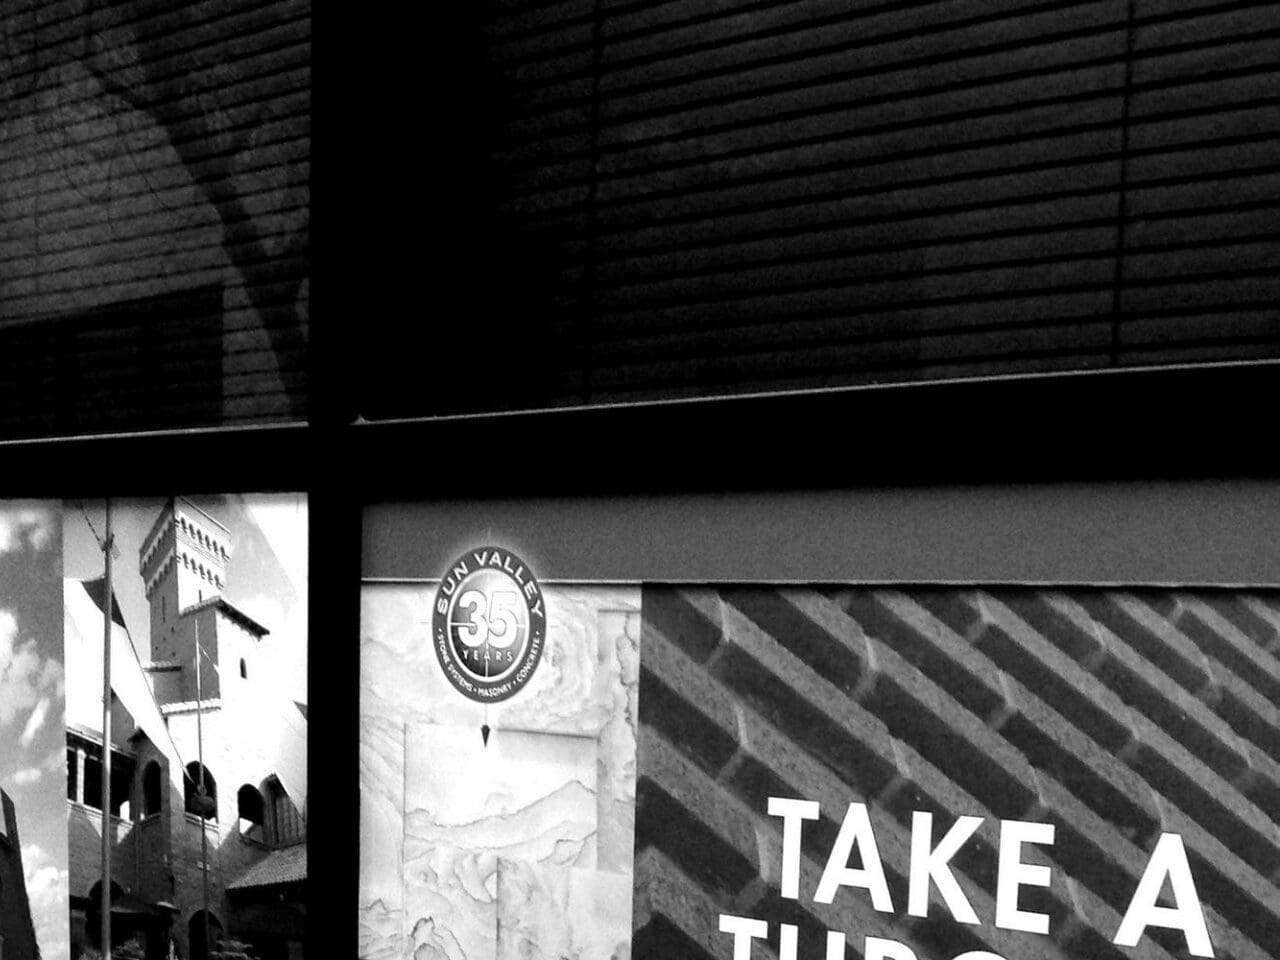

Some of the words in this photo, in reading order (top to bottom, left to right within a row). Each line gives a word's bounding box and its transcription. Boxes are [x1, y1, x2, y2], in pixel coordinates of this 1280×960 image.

[437, 561, 469, 616] SUN
[474, 551, 544, 618] VALLEY
[458, 590, 519, 649] 35
[437, 634, 451, 666] STONE
[447, 663, 474, 692] SYSTEMS
[463, 650, 514, 662] YEARS
[515, 636, 541, 683] CONCRETE
[477, 680, 513, 698] MASONRY
[767, 796, 1056, 935] TAKE
[1113, 832, 1215, 958] A
